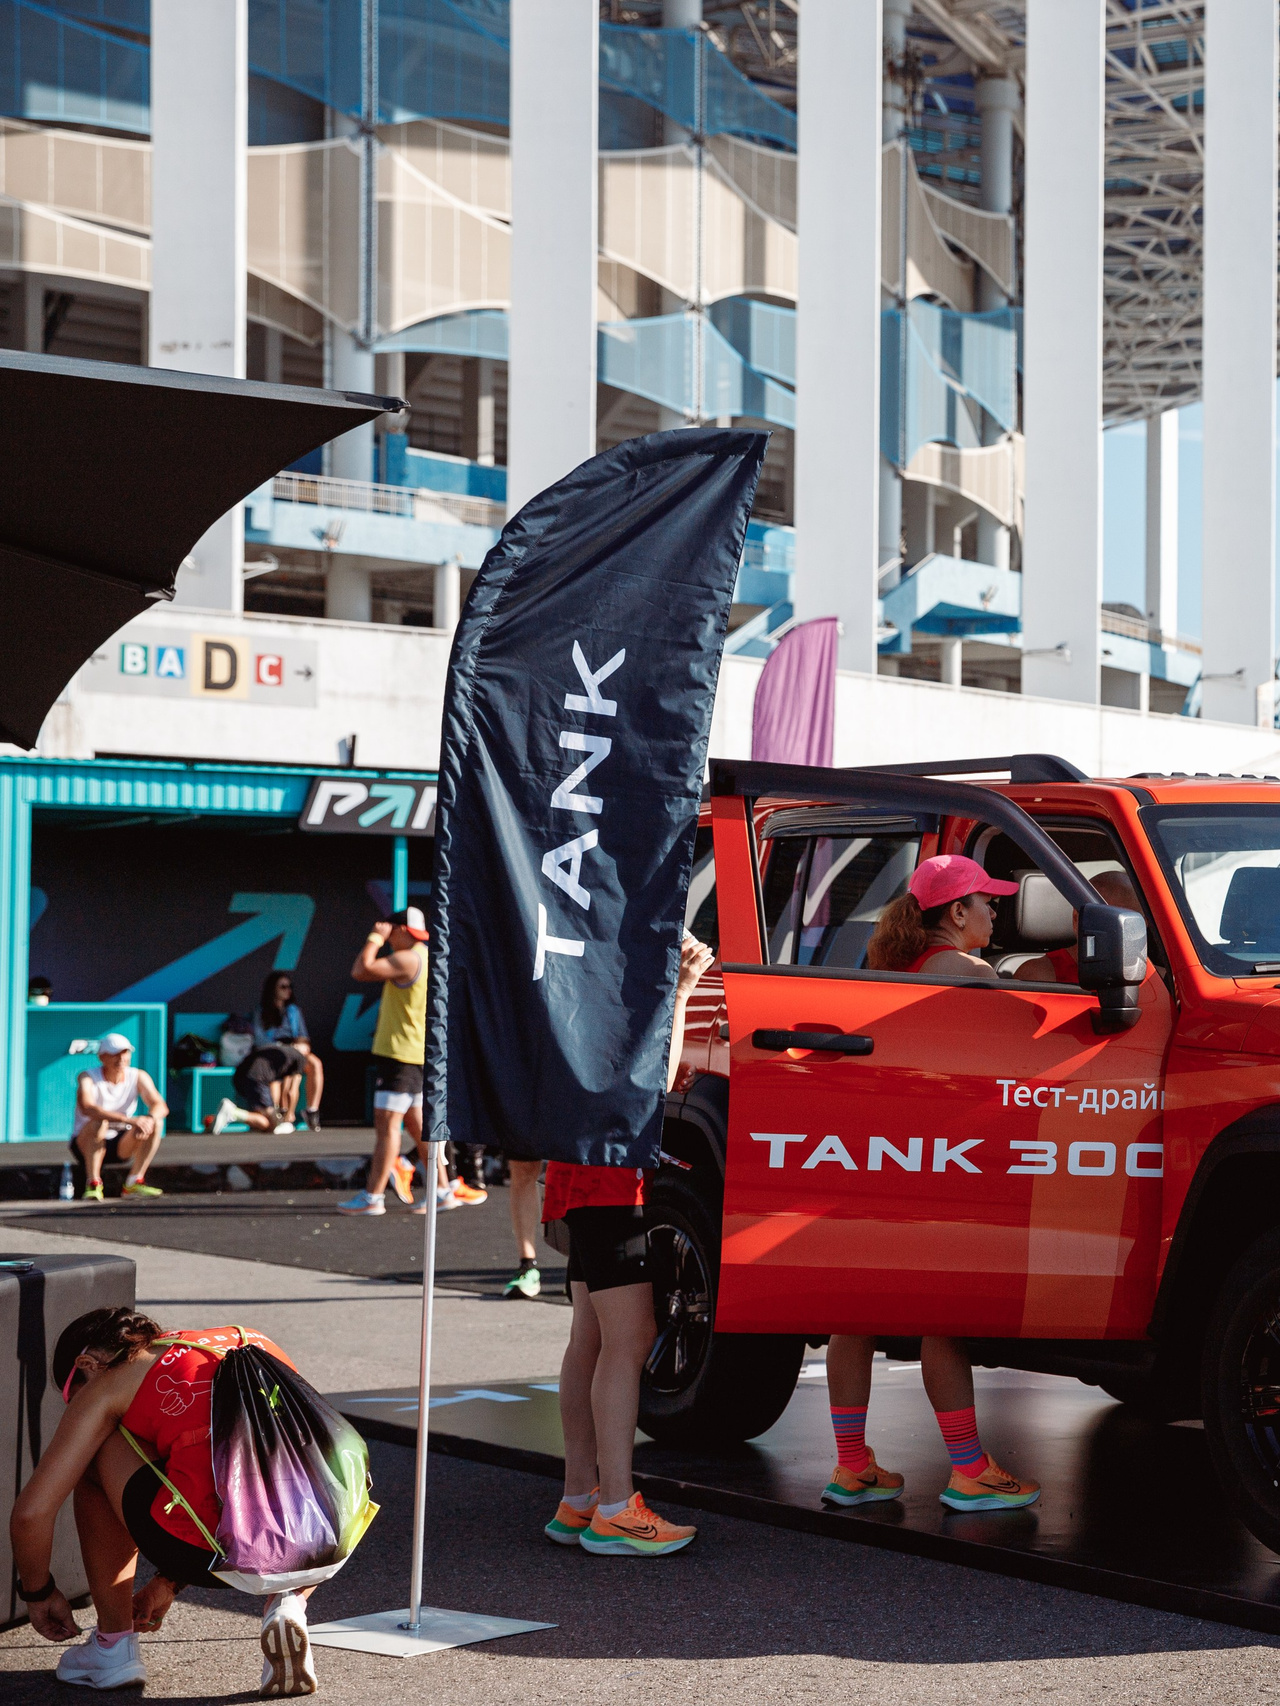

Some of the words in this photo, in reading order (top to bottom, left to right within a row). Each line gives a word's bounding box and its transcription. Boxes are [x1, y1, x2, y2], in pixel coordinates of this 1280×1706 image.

[123, 644, 148, 674] B
[157, 647, 183, 678] A
[203, 641, 238, 690] D
[258, 655, 281, 686] C
[532, 639, 626, 981] TANK
[996, 1079, 1165, 1115] Тест-драй
[749, 1132, 985, 1174] TANK
[1006, 1140, 1164, 1178] 300
